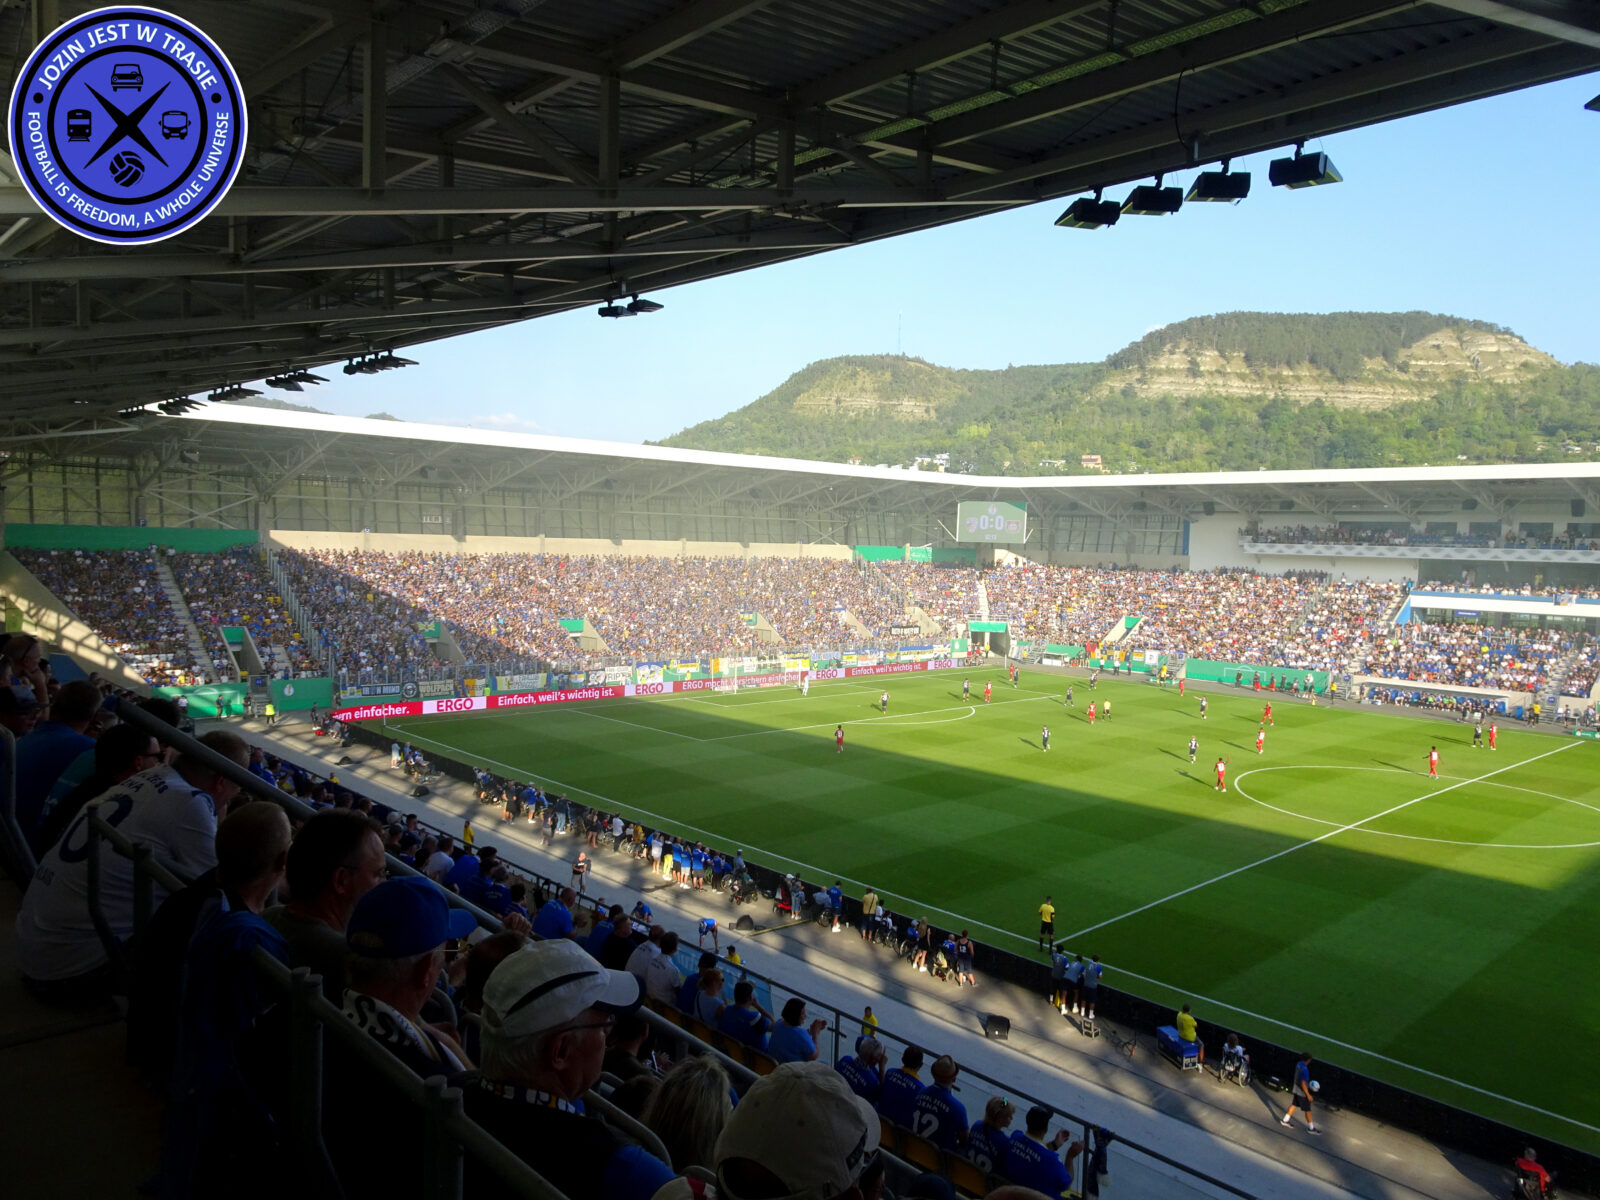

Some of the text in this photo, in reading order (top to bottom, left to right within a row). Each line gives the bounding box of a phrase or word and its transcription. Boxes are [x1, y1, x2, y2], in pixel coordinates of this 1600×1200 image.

[980, 514, 1004, 531] 0:0
[851, 666, 875, 677] Einfach,
[893, 663, 913, 672] wichtig
[934, 659, 953, 669] ERGO
[816, 668, 838, 680] ERGO
[635, 682, 664, 695] ERGO
[682, 680, 704, 690] ERGO
[497, 687, 615, 707] Einfach, weil's wichtig ist.
[354, 704, 410, 719] einfacher.
[436, 698, 474, 713] ERGO
[912, 1109, 939, 1139] 12
